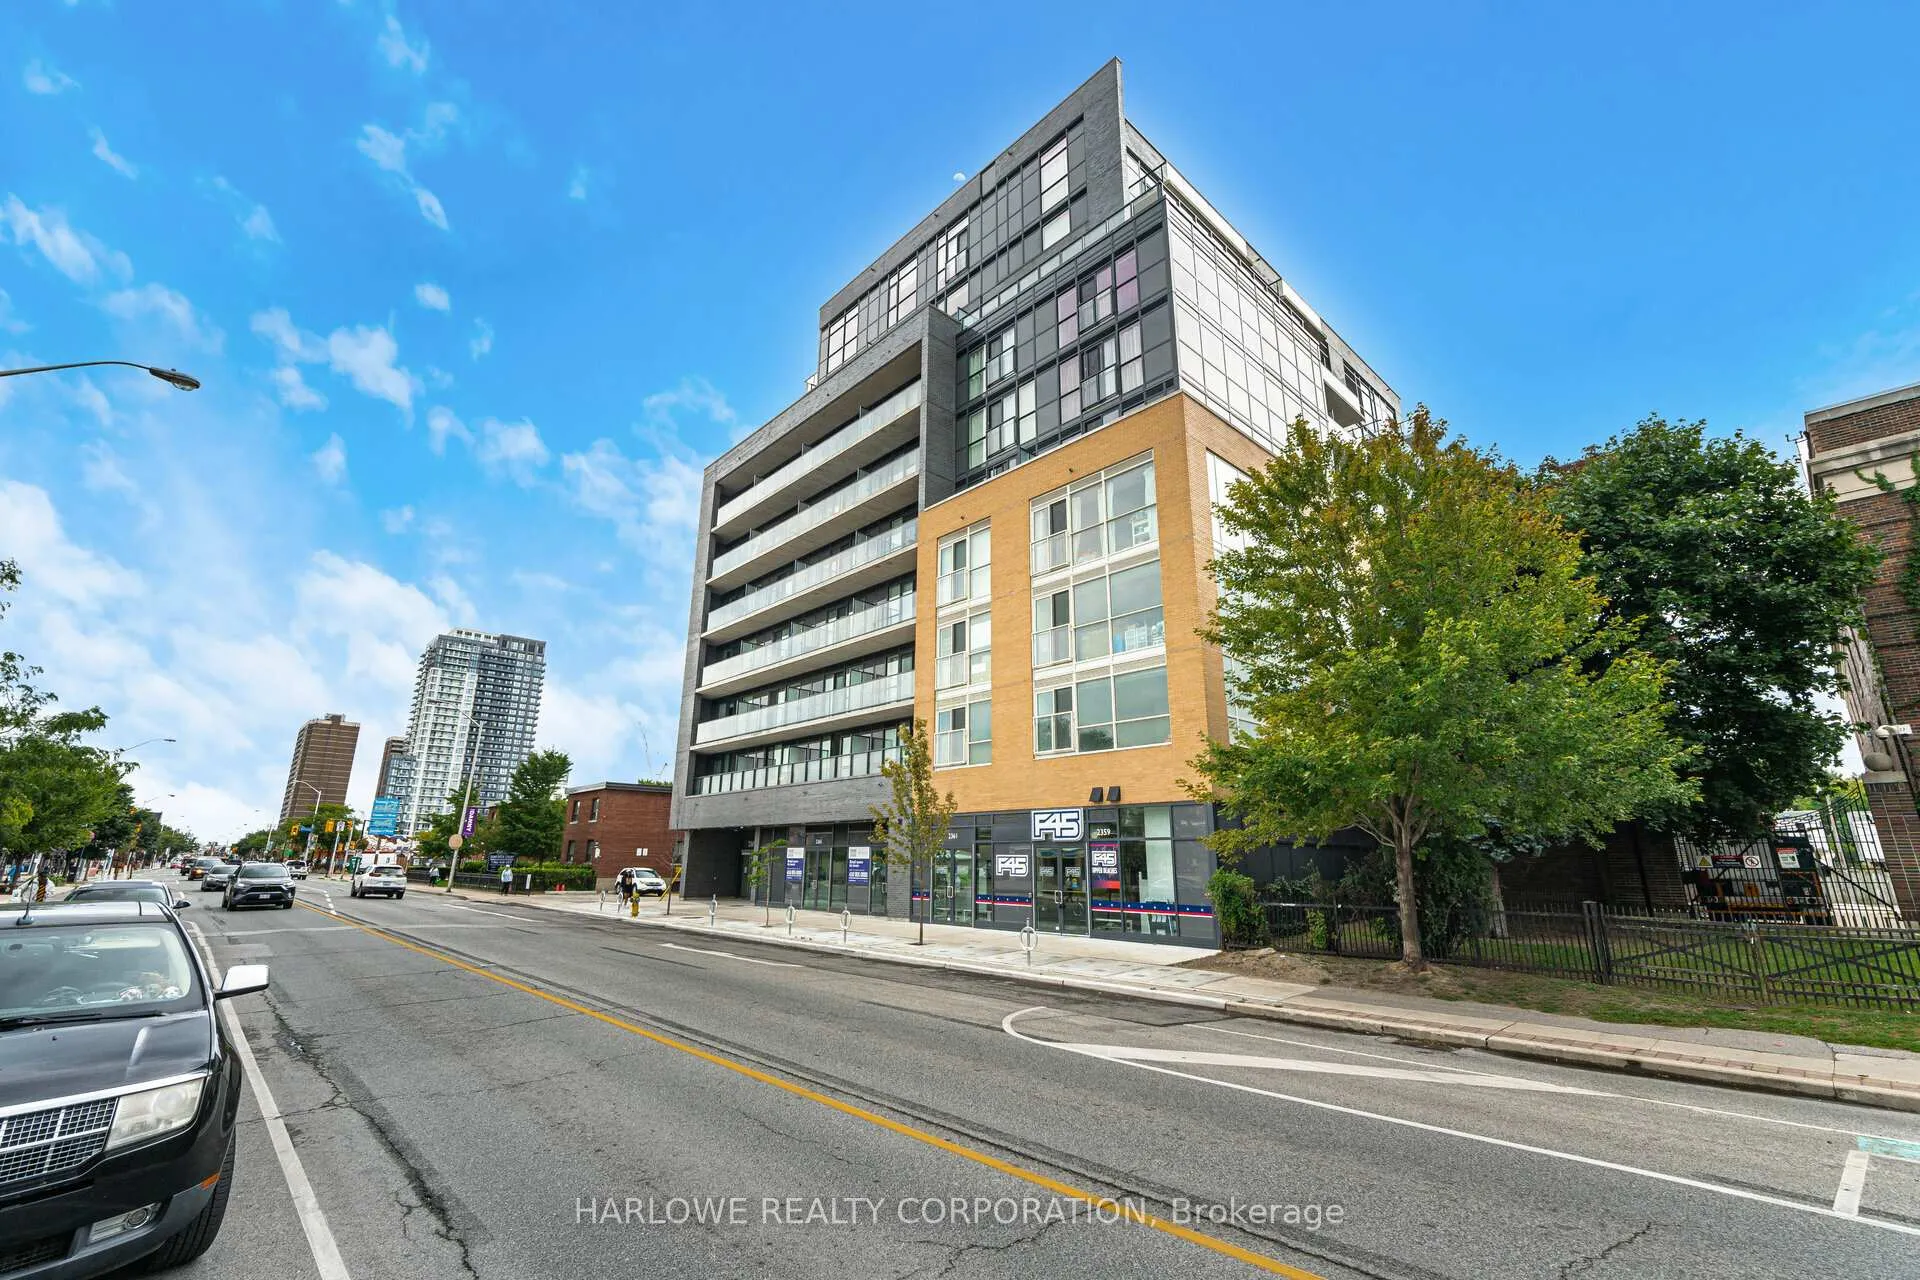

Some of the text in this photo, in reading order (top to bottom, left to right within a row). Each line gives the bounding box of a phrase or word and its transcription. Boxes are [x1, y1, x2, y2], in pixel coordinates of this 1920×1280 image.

[1032, 811, 1081, 839] F45
[1096, 828, 1111, 836] 2359
[997, 856, 1028, 875] F45
[1093, 852, 1116, 865] F45
